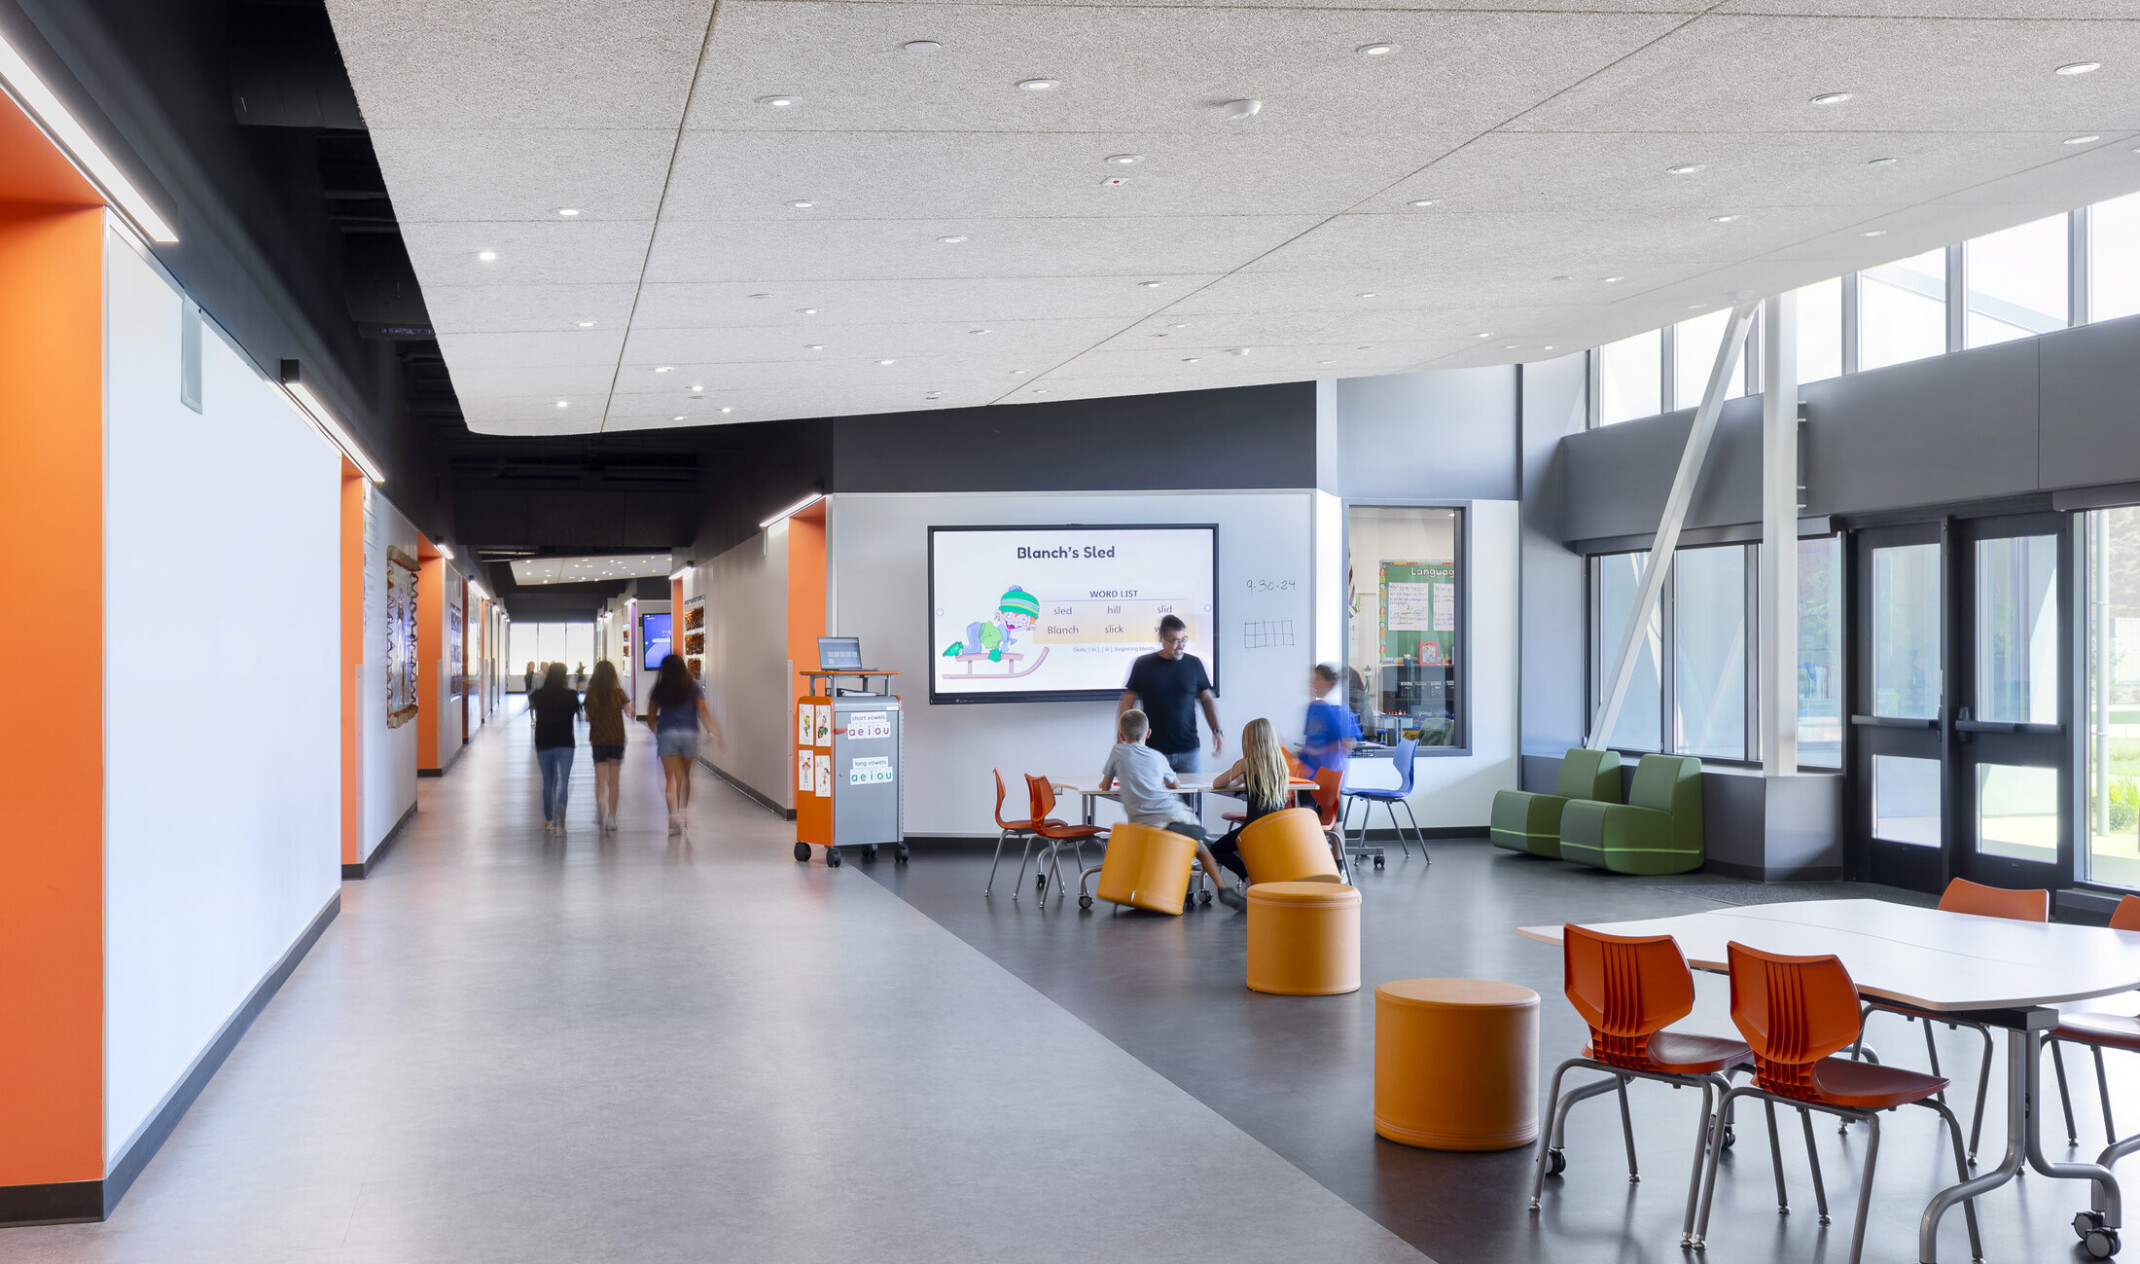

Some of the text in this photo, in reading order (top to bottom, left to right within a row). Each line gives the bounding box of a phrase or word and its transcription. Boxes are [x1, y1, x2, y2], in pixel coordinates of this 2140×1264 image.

[1017, 545, 1115, 559] Blanch's Sled
[1246, 579, 1296, 593] 9-30-24
[1089, 589, 1138, 598] WORD LIST
[1053, 604, 1173, 615] sled hill slid
[1047, 624, 1124, 635] Blanch slick
